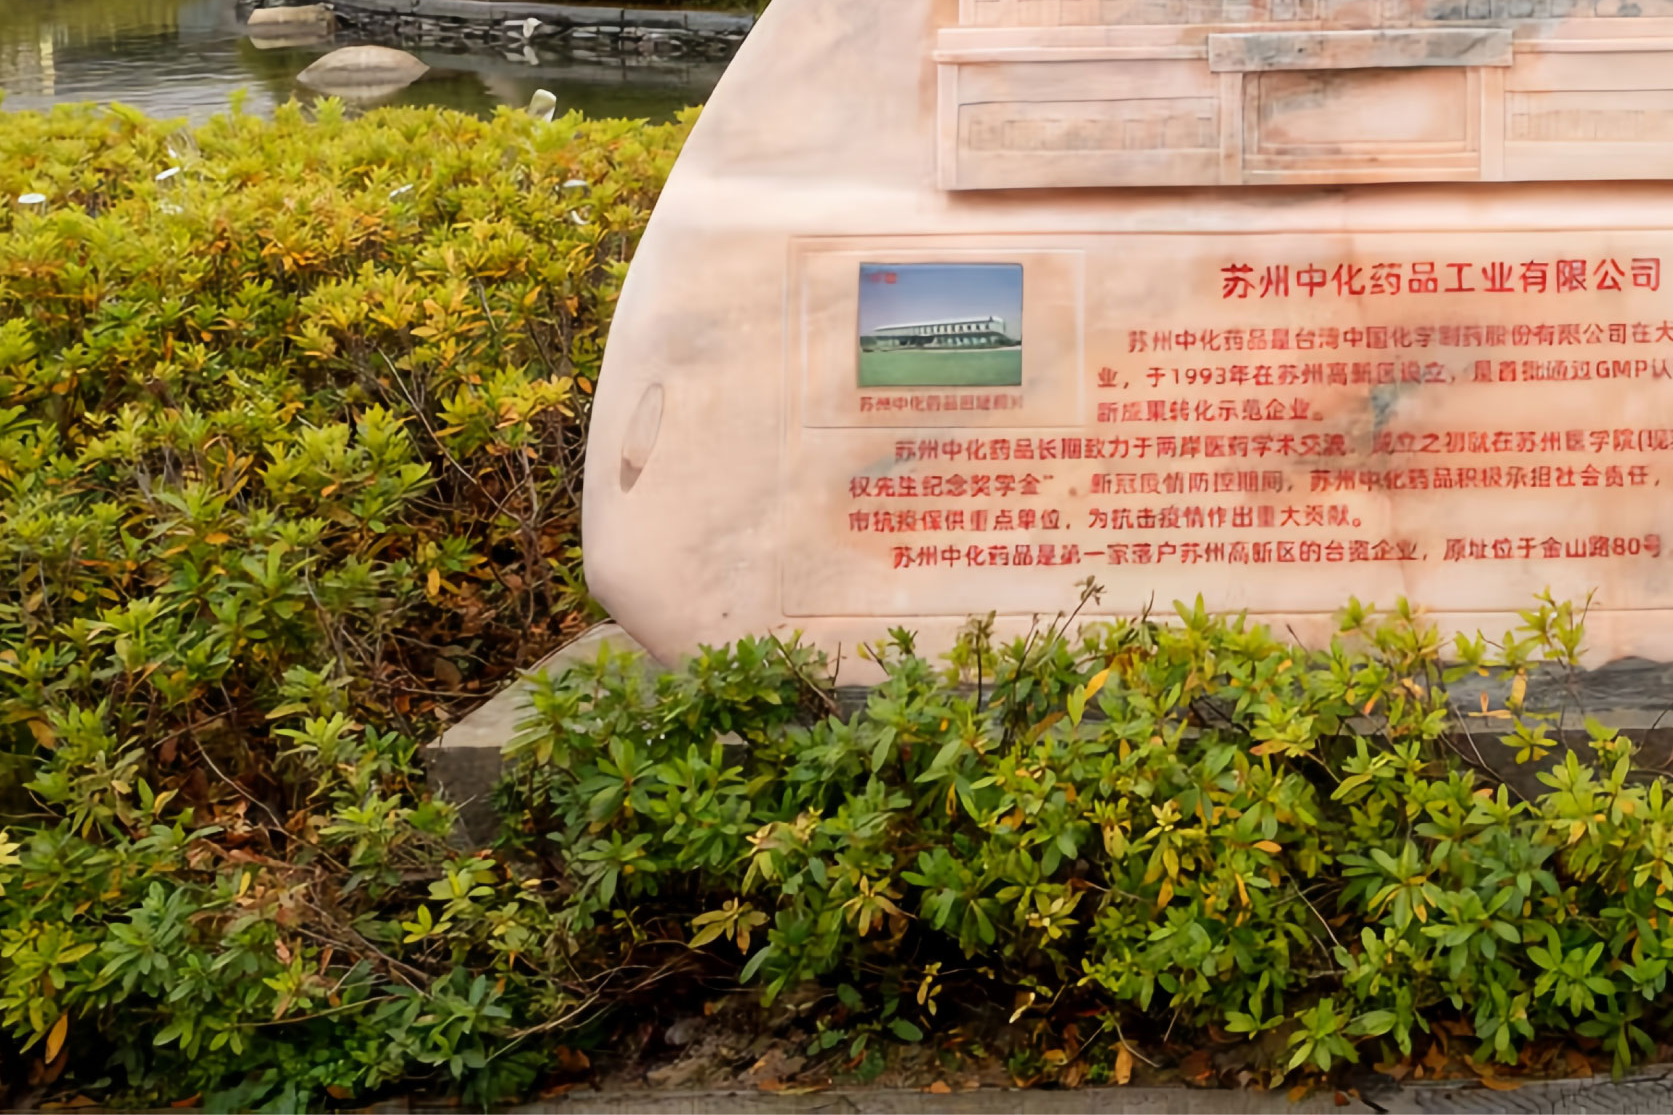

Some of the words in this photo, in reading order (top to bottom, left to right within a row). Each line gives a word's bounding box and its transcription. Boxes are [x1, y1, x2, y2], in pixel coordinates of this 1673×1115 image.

[1221, 257, 1661, 299] 苏州中化药品工业有限公司
